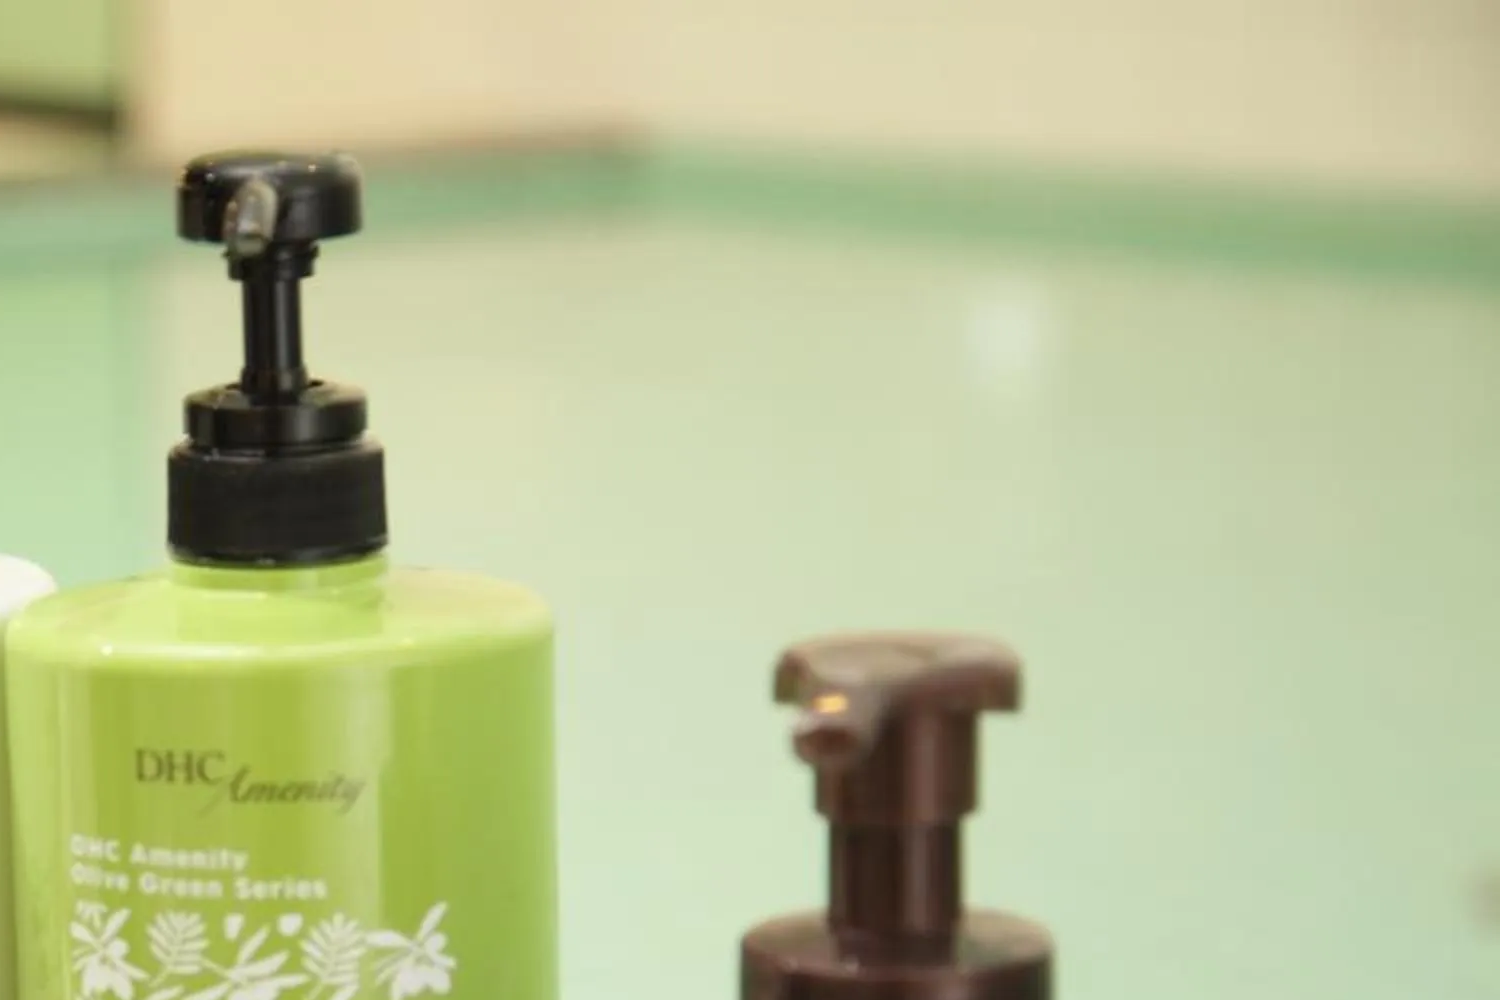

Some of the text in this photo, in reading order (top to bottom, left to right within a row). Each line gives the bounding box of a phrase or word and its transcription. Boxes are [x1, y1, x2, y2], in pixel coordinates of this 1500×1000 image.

[134, 748, 367, 816] DHC Amenity
[70, 834, 248, 871] DHC Amenity
[70, 864, 327, 899] Olive Green Series
